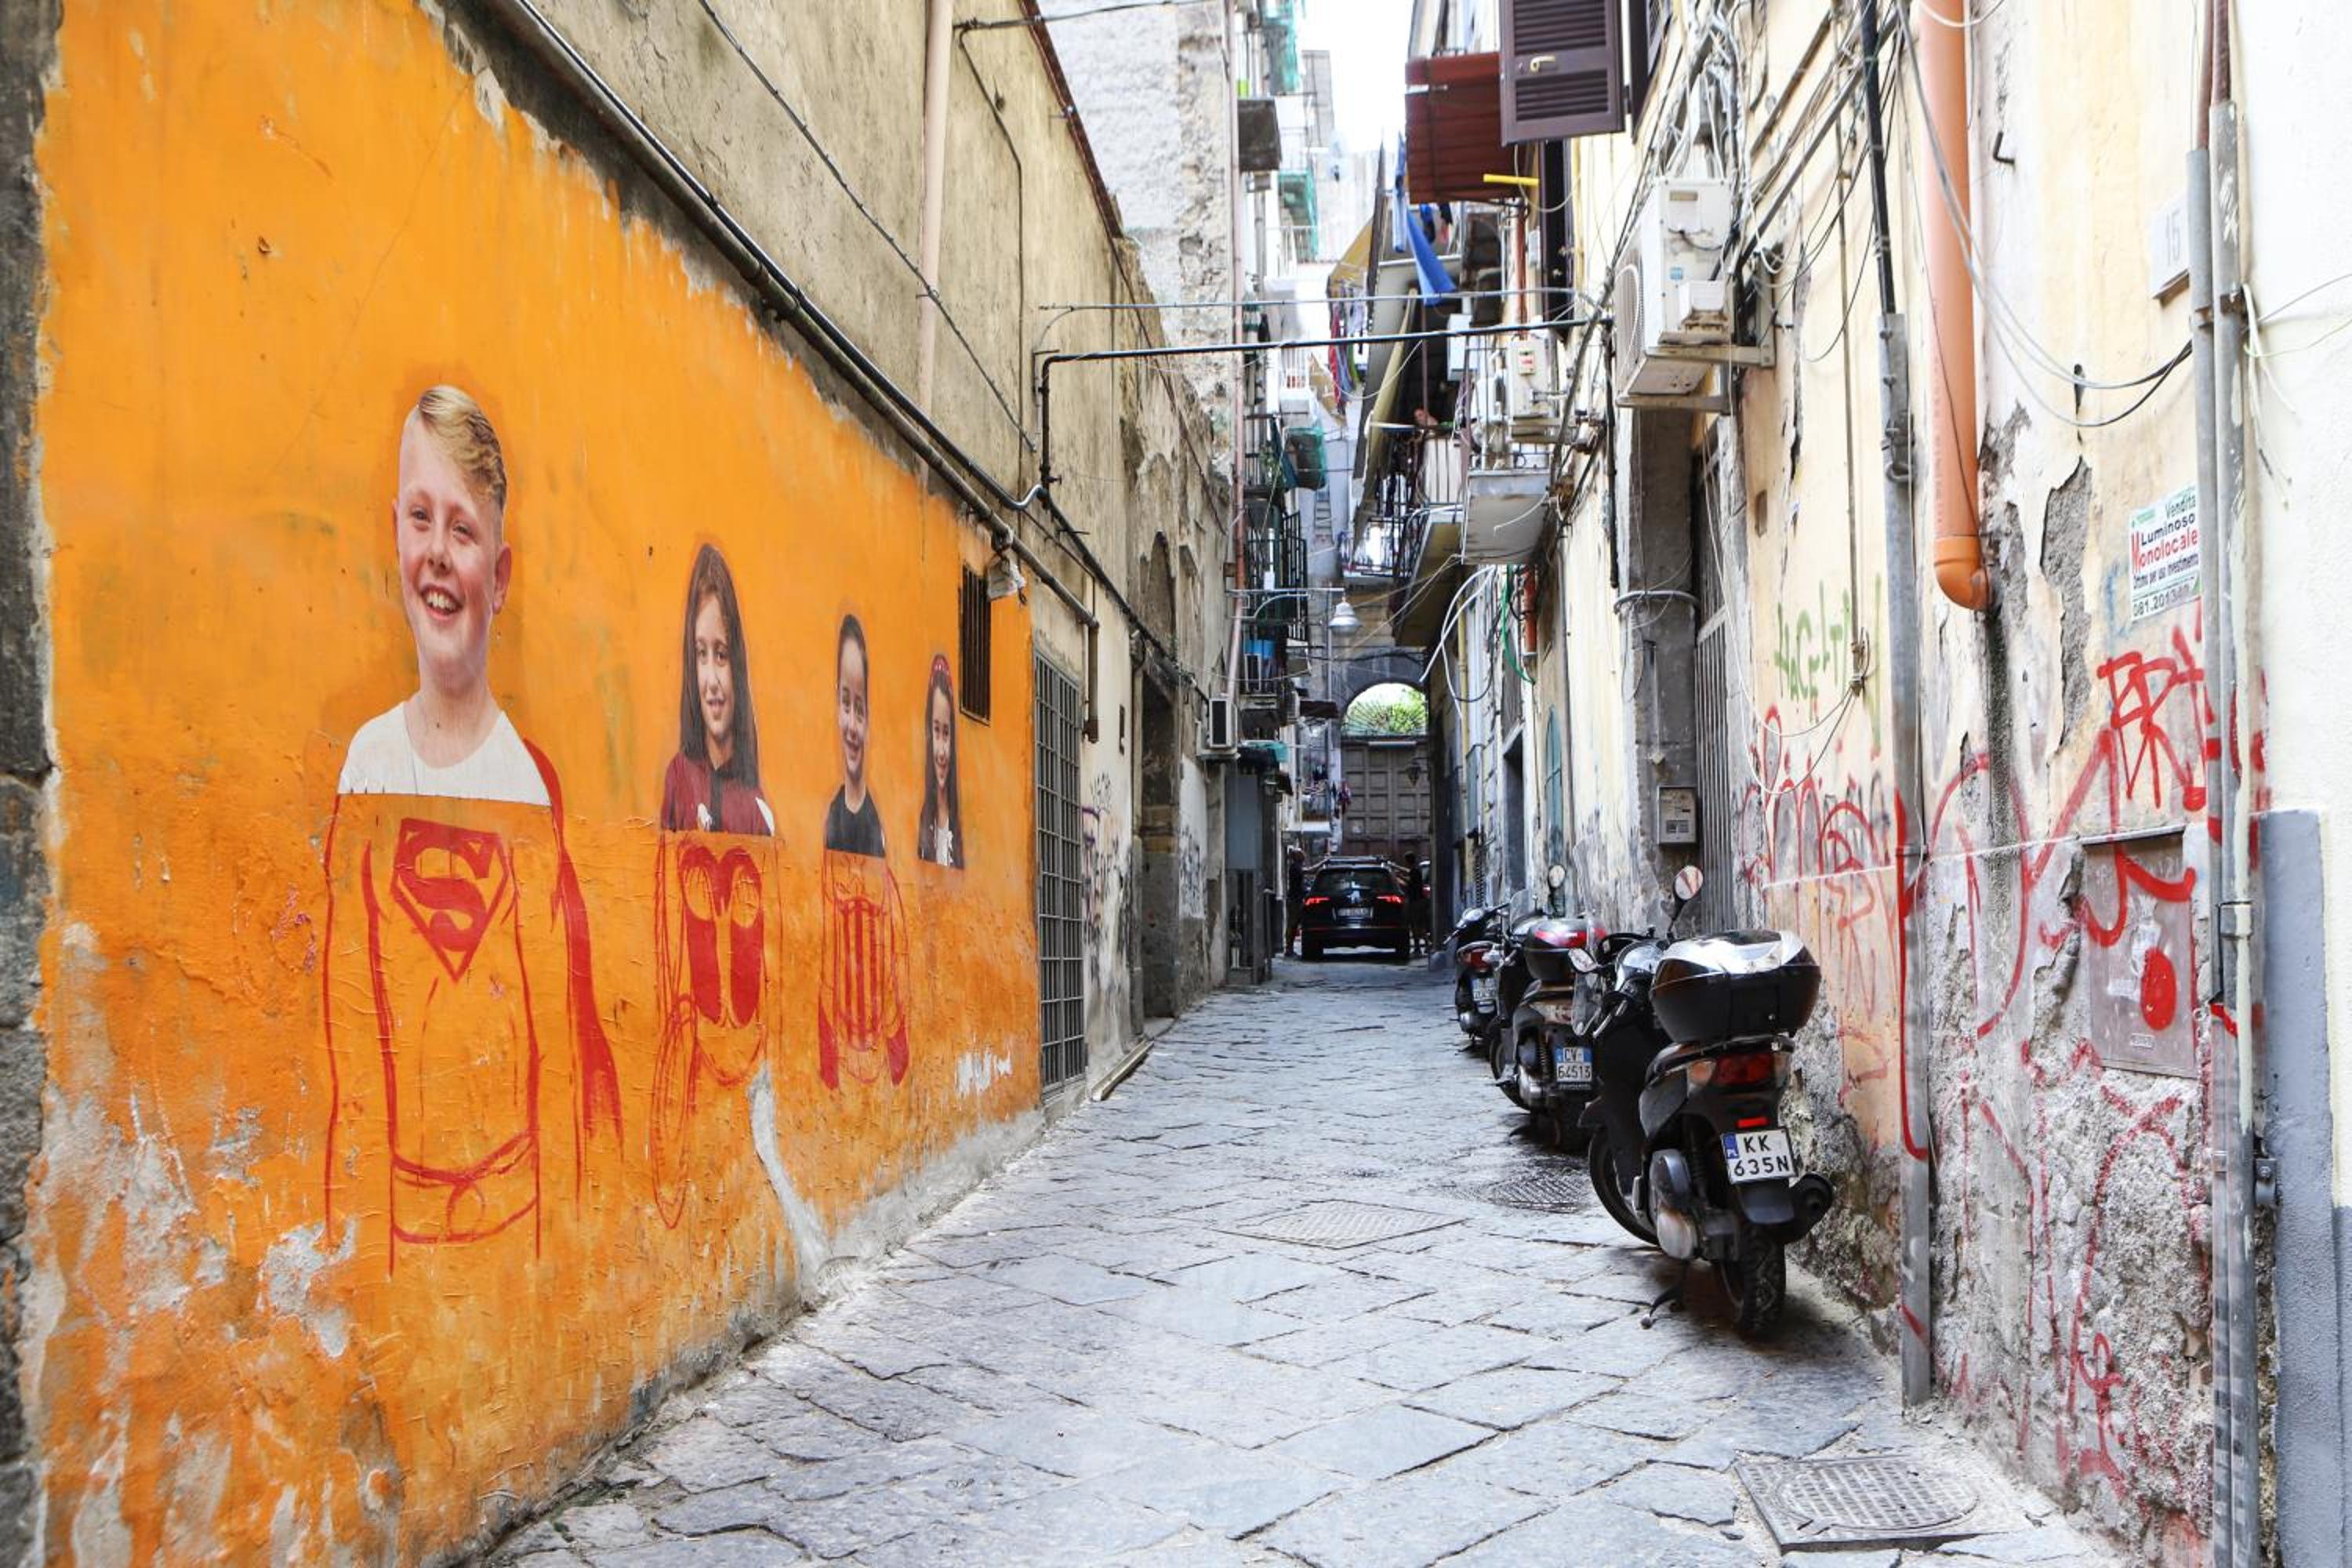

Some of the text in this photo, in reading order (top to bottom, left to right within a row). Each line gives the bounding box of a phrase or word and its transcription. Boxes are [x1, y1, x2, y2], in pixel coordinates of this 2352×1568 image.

[2141, 513, 2196, 546] Luminoso
[2132, 527, 2198, 575] Monolocale
[1744, 1134, 1771, 1153] KK
[1733, 1155, 1789, 1177] 635N
